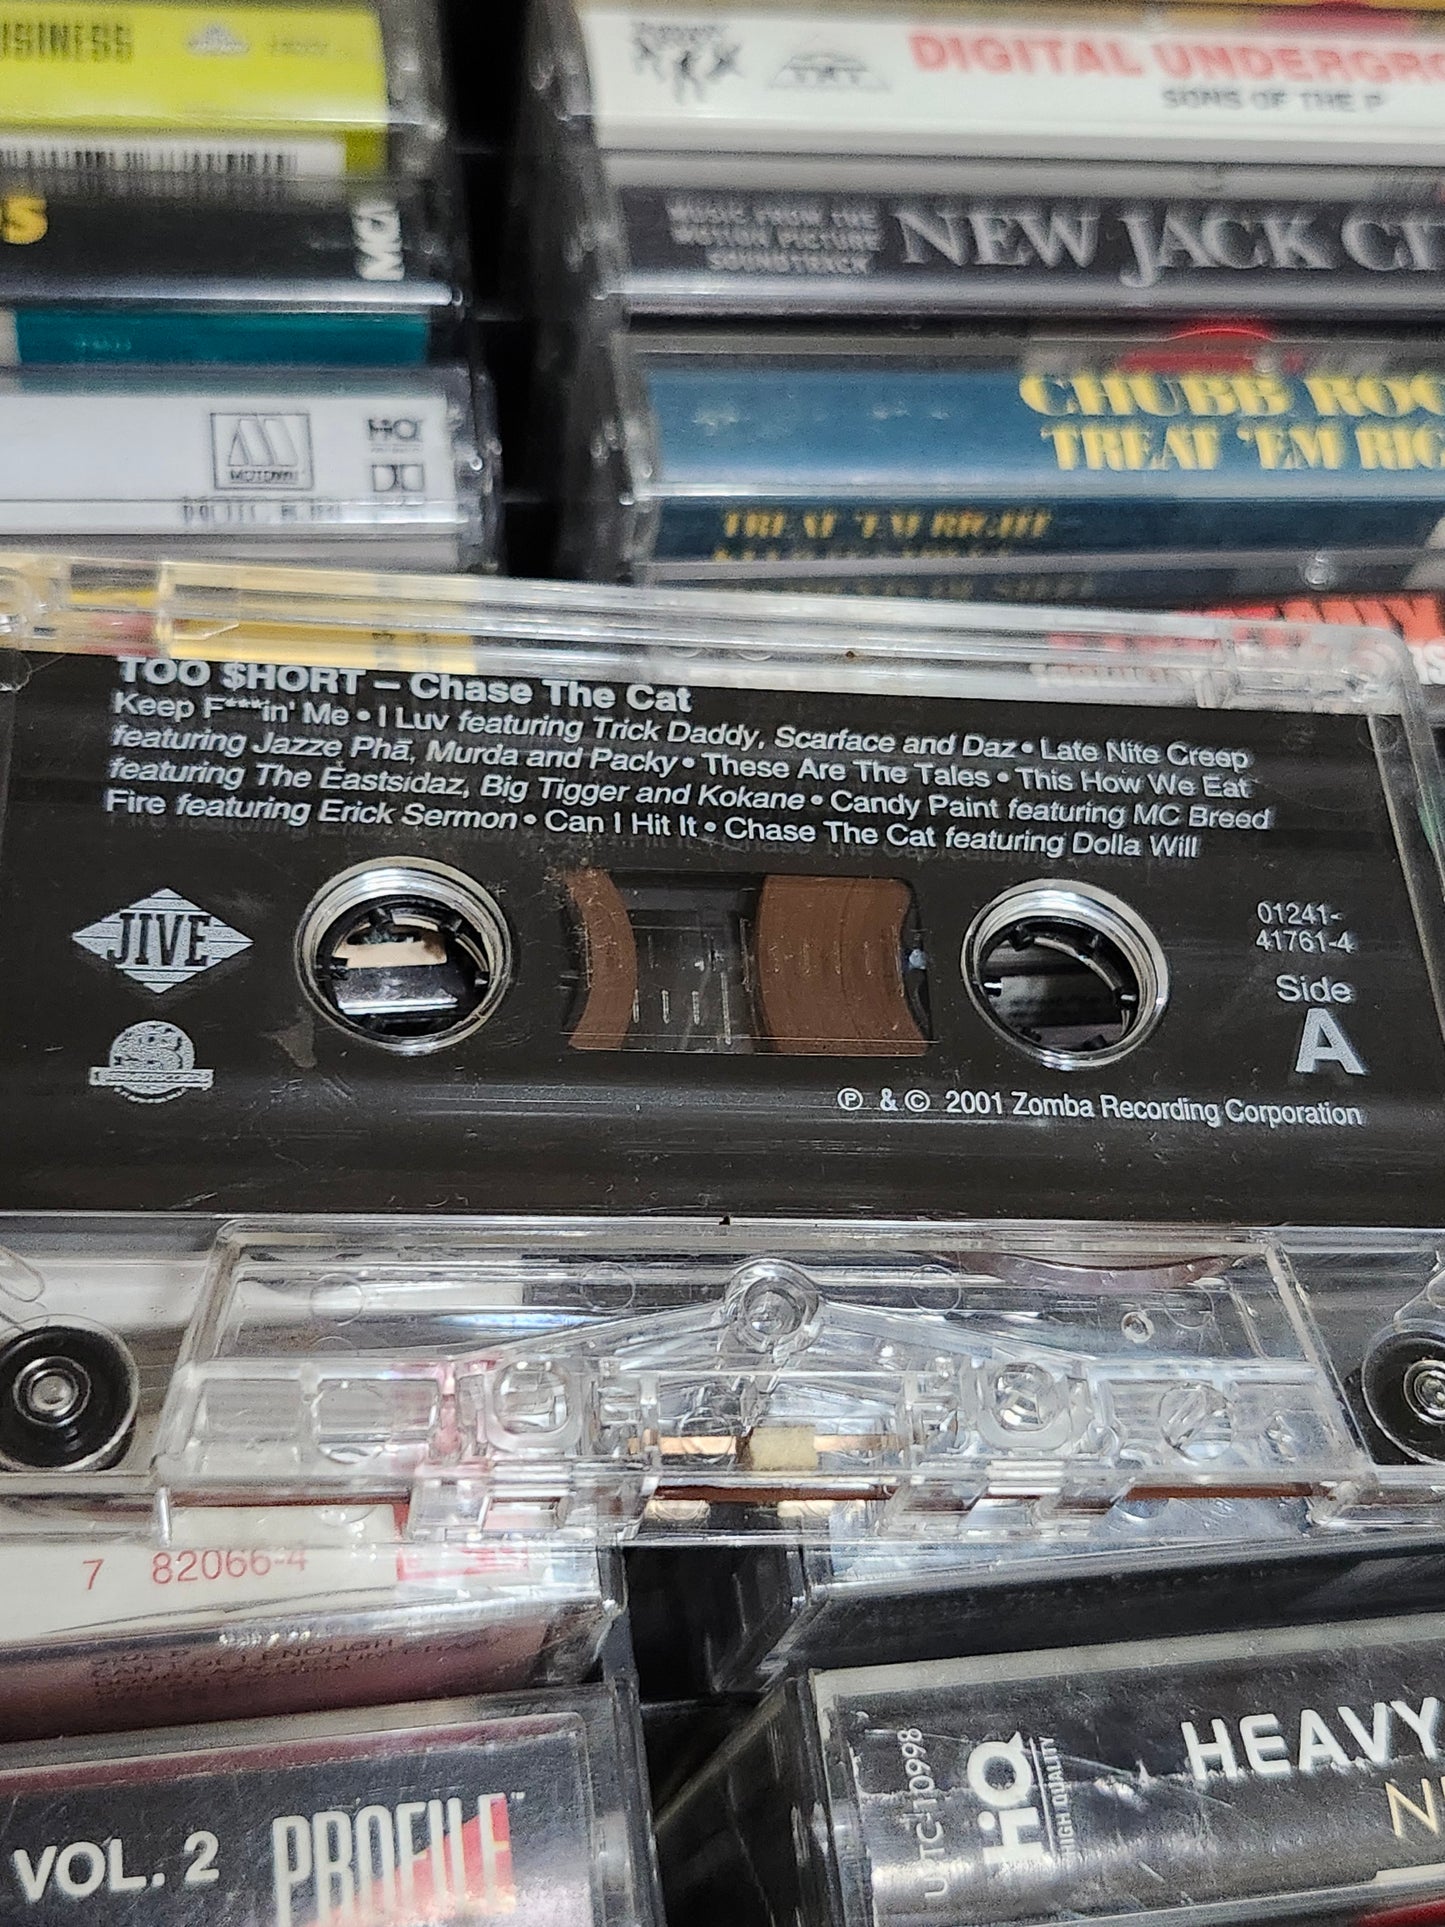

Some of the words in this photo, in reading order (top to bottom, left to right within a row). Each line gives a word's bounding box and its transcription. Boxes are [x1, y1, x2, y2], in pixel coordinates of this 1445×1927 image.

[907, 33, 1145, 79] DIGITAL
[1163, 89, 1243, 111] SONS
[1250, 90, 1288, 111] OF
[1299, 91, 1356, 113] THE
[890, 211, 1099, 267] NEW
[1116, 214, 1335, 289] JACK
[1018, 372, 1293, 417] CHUBB
[1040, 420, 1221, 471] TREAT
[1236, 422, 1344, 471] 'EM
[116, 656, 211, 687] TOO
[221, 661, 367, 696] $HORT
[408, 672, 533, 706] Chase
[542, 679, 616, 709] The
[626, 684, 693, 714] Cat
[110, 724, 248, 758] featuring
[252, 732, 343, 758] Jazze
[425, 740, 519, 767] Murda
[526, 747, 583, 770] and
[590, 749, 679, 780] Packy
[700, 753, 790, 779] These
[797, 757, 847, 782] Are
[852, 759, 908, 786] The
[913, 763, 992, 789] Tales
[1014, 767, 1074, 793] This
[1081, 769, 1142, 796] How
[1147, 771, 1197, 798] We
[1202, 774, 1253, 800] Eat
[112, 692, 195, 723] Keep
[302, 702, 350, 727] Me
[377, 705, 387, 729] I
[395, 707, 450, 732] Luv
[457, 710, 584, 744] featuring
[593, 716, 662, 742] Trick
[667, 720, 766, 752] Daddy,
[774, 725, 896, 754] Scarface
[902, 731, 956, 756] and
[962, 734, 1018, 759] Daz
[1039, 736, 1099, 763] Late
[1106, 739, 1161, 766] Nite
[1167, 741, 1251, 774] Creep
[108, 757, 247, 792] featuring
[255, 763, 313, 789] The
[319, 766, 470, 800] Eastsidaz,
[479, 774, 529, 805] Big
[538, 777, 631, 808] Tigger
[634, 782, 690, 806] and
[697, 784, 806, 812] Kokane
[829, 790, 921, 821] Candy
[928, 795, 1001, 820] Paint
[1008, 797, 1128, 832] featuring
[1132, 802, 1182, 828] MC
[1188, 805, 1275, 831] Breed
[105, 789, 167, 816] Fire
[174, 791, 313, 827] featuring
[317, 798, 398, 826] Erick
[400, 802, 518, 831] Sermon
[544, 809, 605, 835] Can
[612, 810, 622, 835] I
[631, 812, 673, 838] Hit
[680, 814, 698, 839] It
[724, 816, 817, 844] Chase
[823, 820, 879, 846] The
[886, 822, 937, 849] Cat
[944, 823, 1065, 859] featuring
[1072, 832, 1142, 858] Dolla
[1149, 833, 1200, 860] Will
[107, 912, 212, 967] JIVE
[1255, 928, 1357, 954] 41761-4
[1256, 900, 1344, 926] 01241-
[1275, 974, 1355, 1004] Side
[1295, 1007, 1368, 1076] A
[879, 1087, 899, 1112] &
[945, 1089, 1004, 1115] 2001
[1010, 1091, 1096, 1119] Zomba
[1099, 1093, 1222, 1129] Recording
[1224, 1097, 1365, 1129] Corporation
[82, 1558, 105, 1591] 7
[151, 1544, 309, 1585] 82066-4
[1179, 1696, 1441, 1781] HEAVY
[1038, 1736, 1073, 1811] QUALITY
[897, 1727, 949, 1899] UTC-10998
[11, 1837, 167, 1904] VOL.
[183, 1829, 221, 1884] 2
